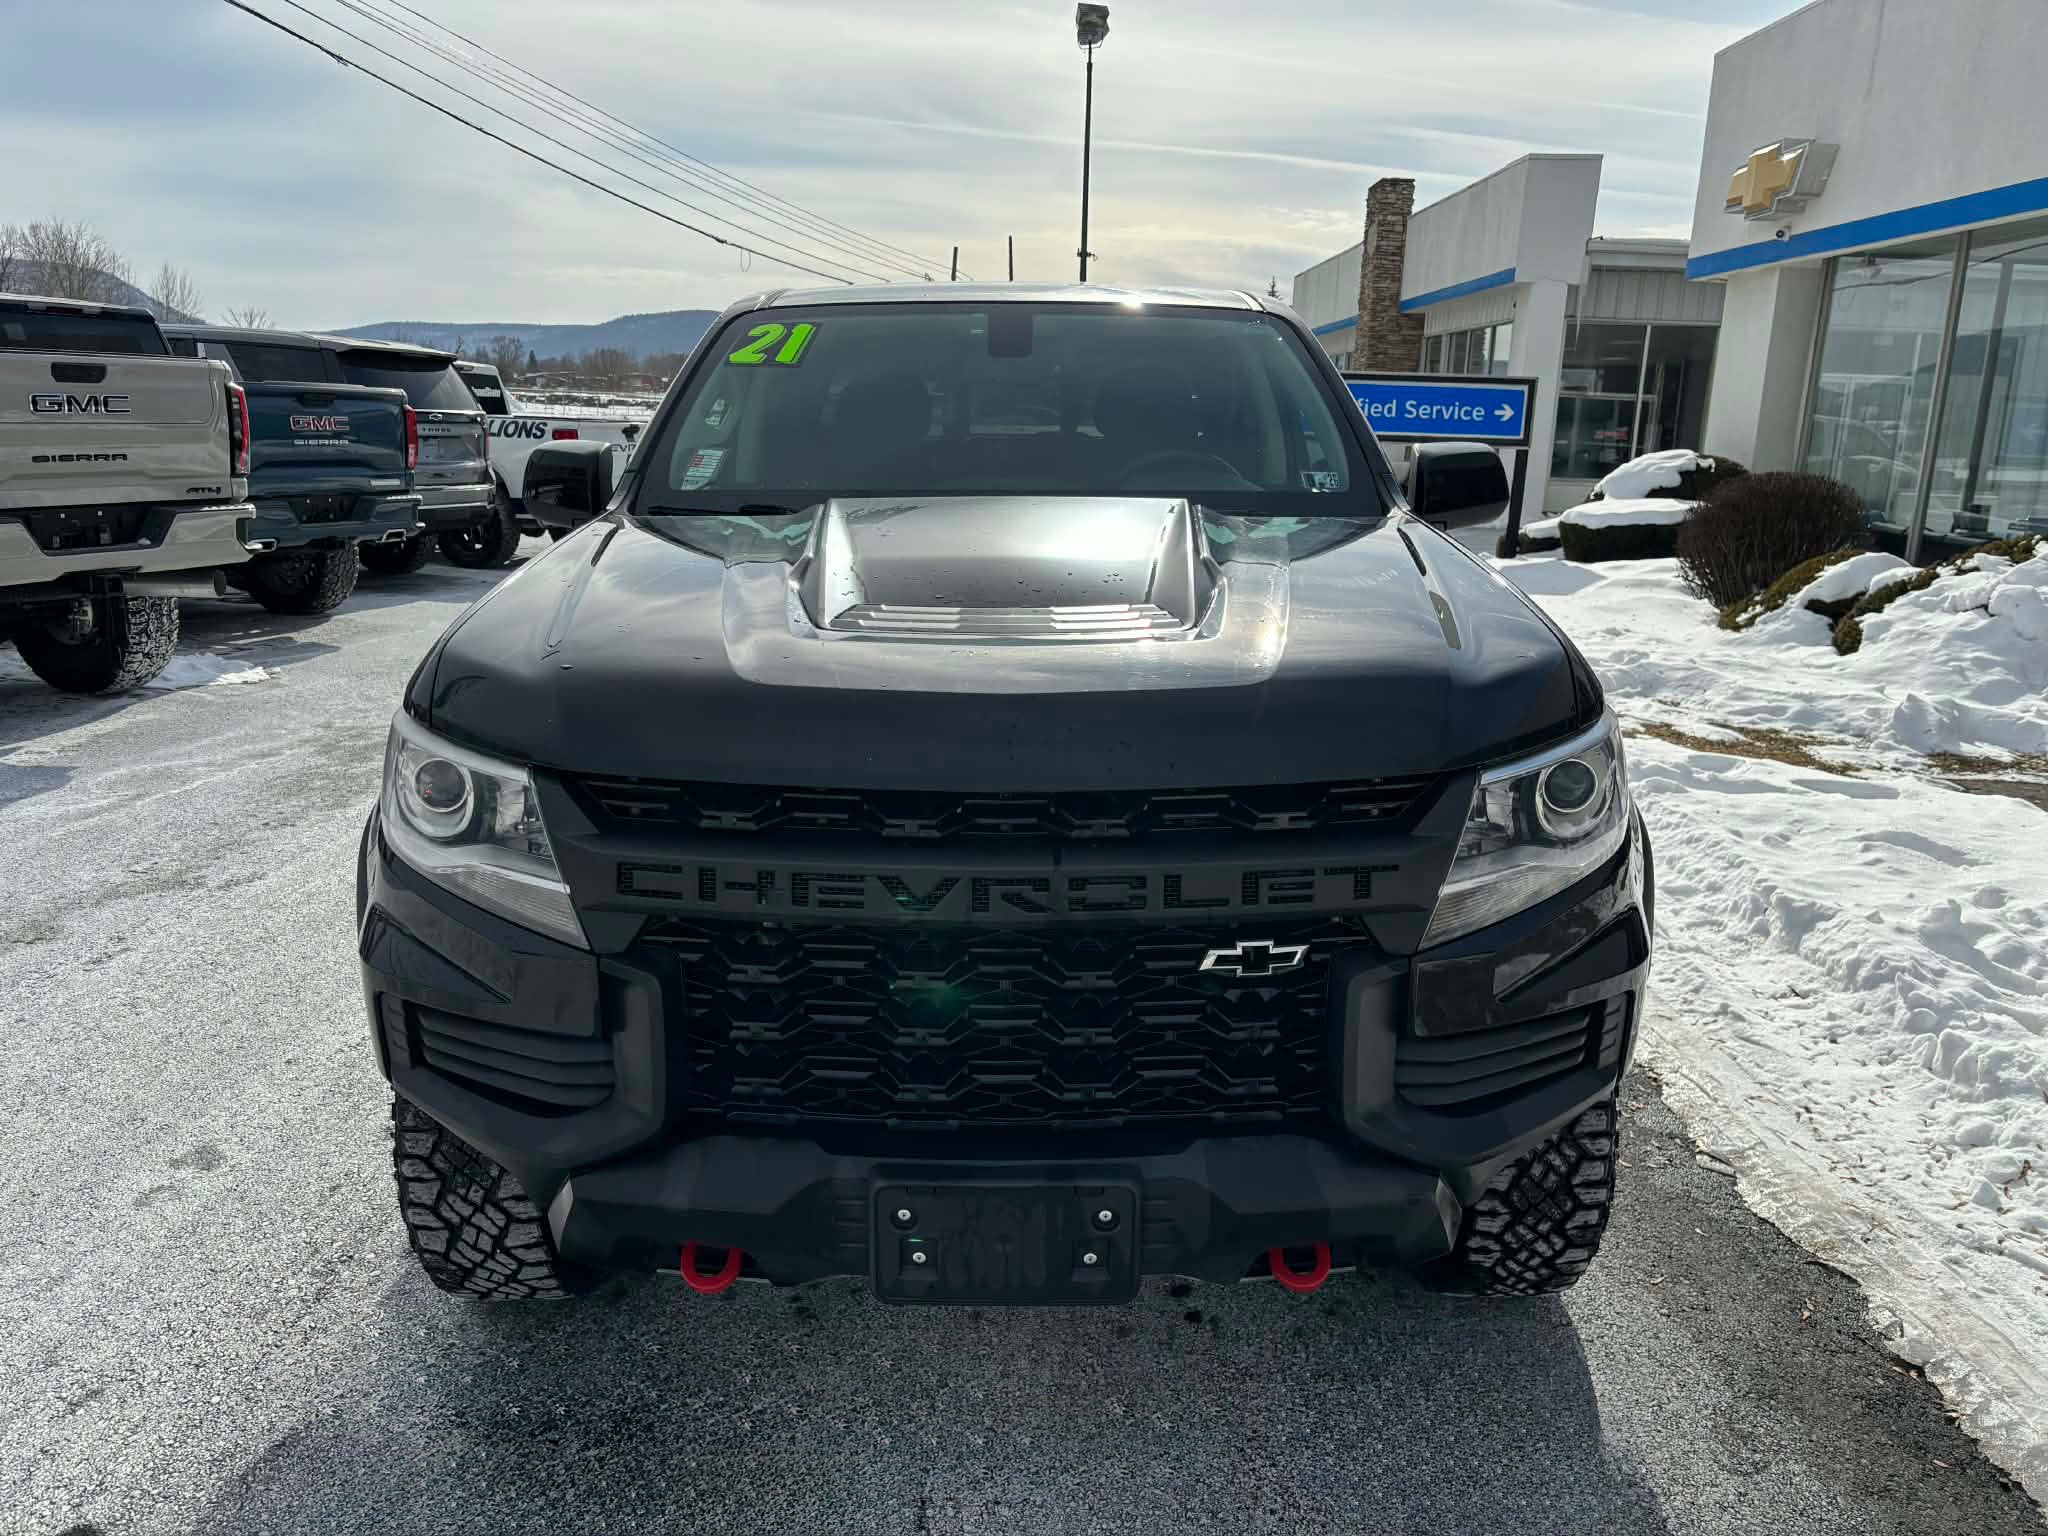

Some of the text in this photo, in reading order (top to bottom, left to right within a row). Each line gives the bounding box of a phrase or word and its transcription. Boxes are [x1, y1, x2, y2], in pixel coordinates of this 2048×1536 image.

[728, 323, 816, 364] 21
[29, 393, 130, 415] GMC
[1404, 401, 1485, 421] Service
[290, 415, 350, 431] GMC
[31, 453, 128, 463] SIERRA
[185, 486, 222, 496] AT4
[616, 862, 1400, 913] CHEVROLET
